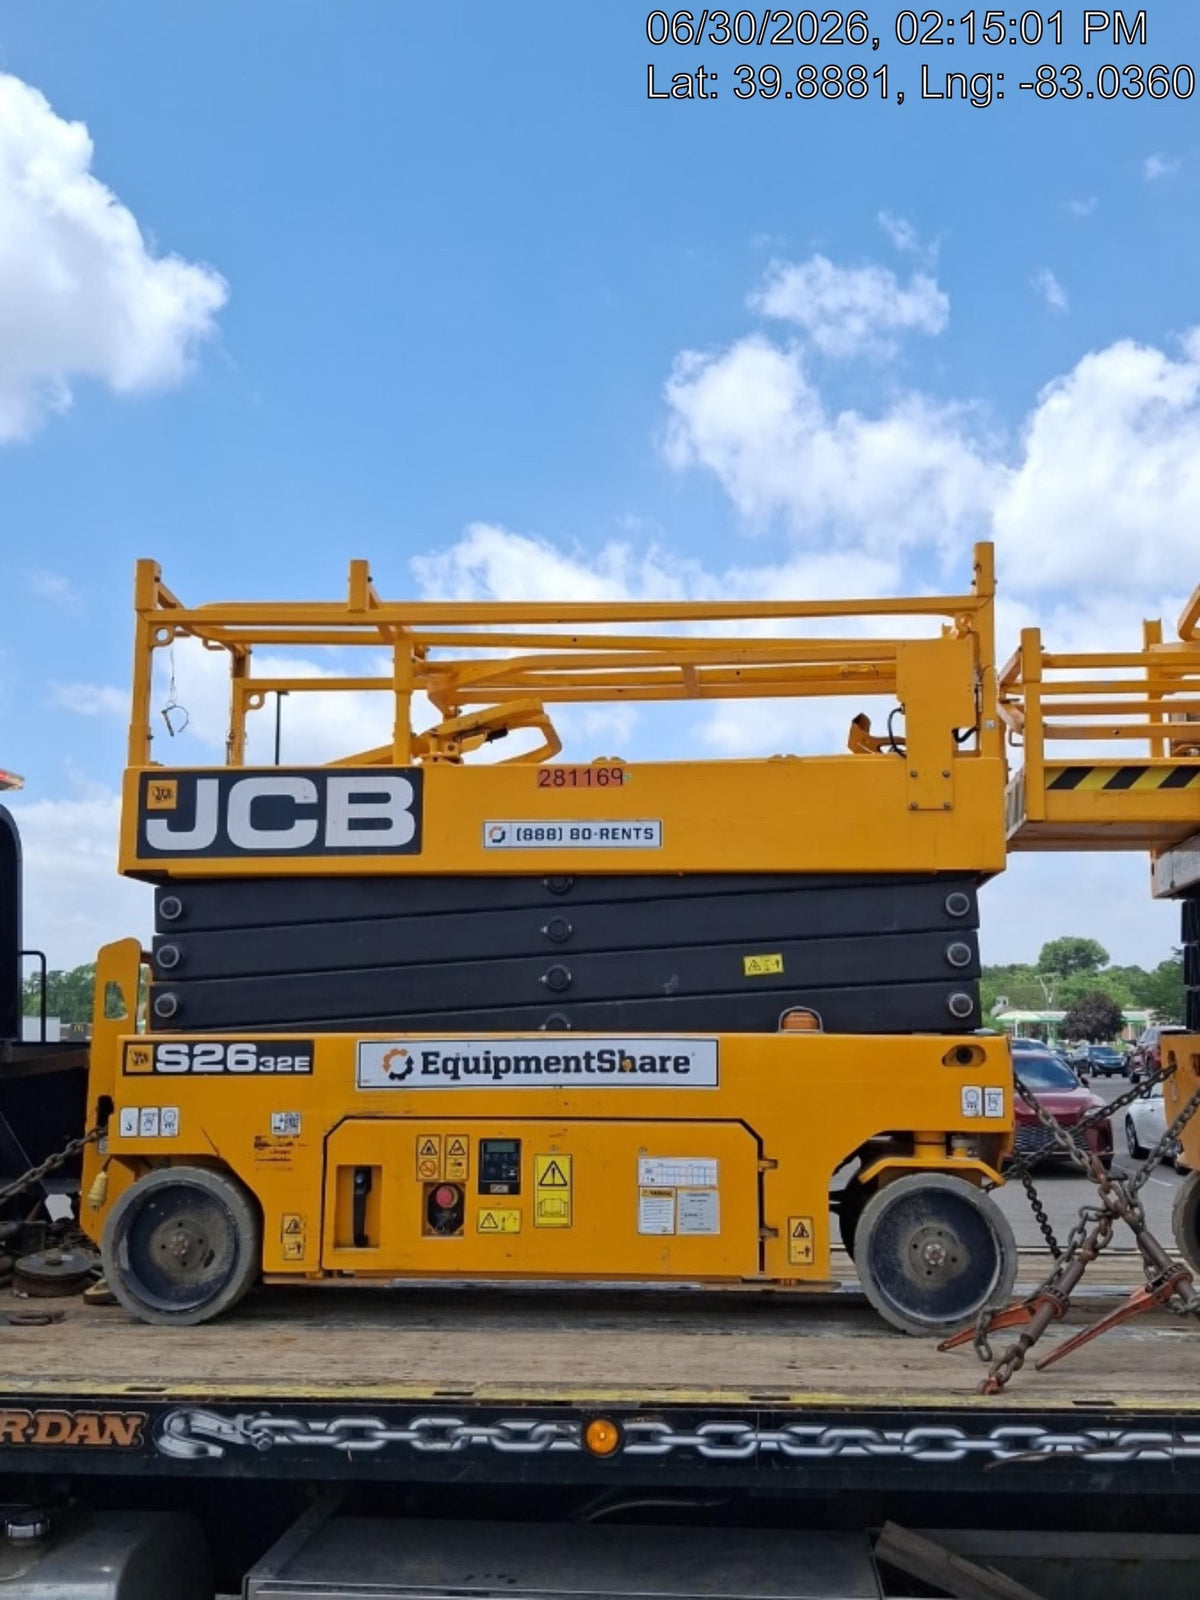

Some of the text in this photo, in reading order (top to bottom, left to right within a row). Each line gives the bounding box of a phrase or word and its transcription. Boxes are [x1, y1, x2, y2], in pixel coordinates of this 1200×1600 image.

[539, 767, 623, 787] 281169
[146, 776, 415, 850] JCB
[420, 1049, 690, 1080] EquipmentShare
